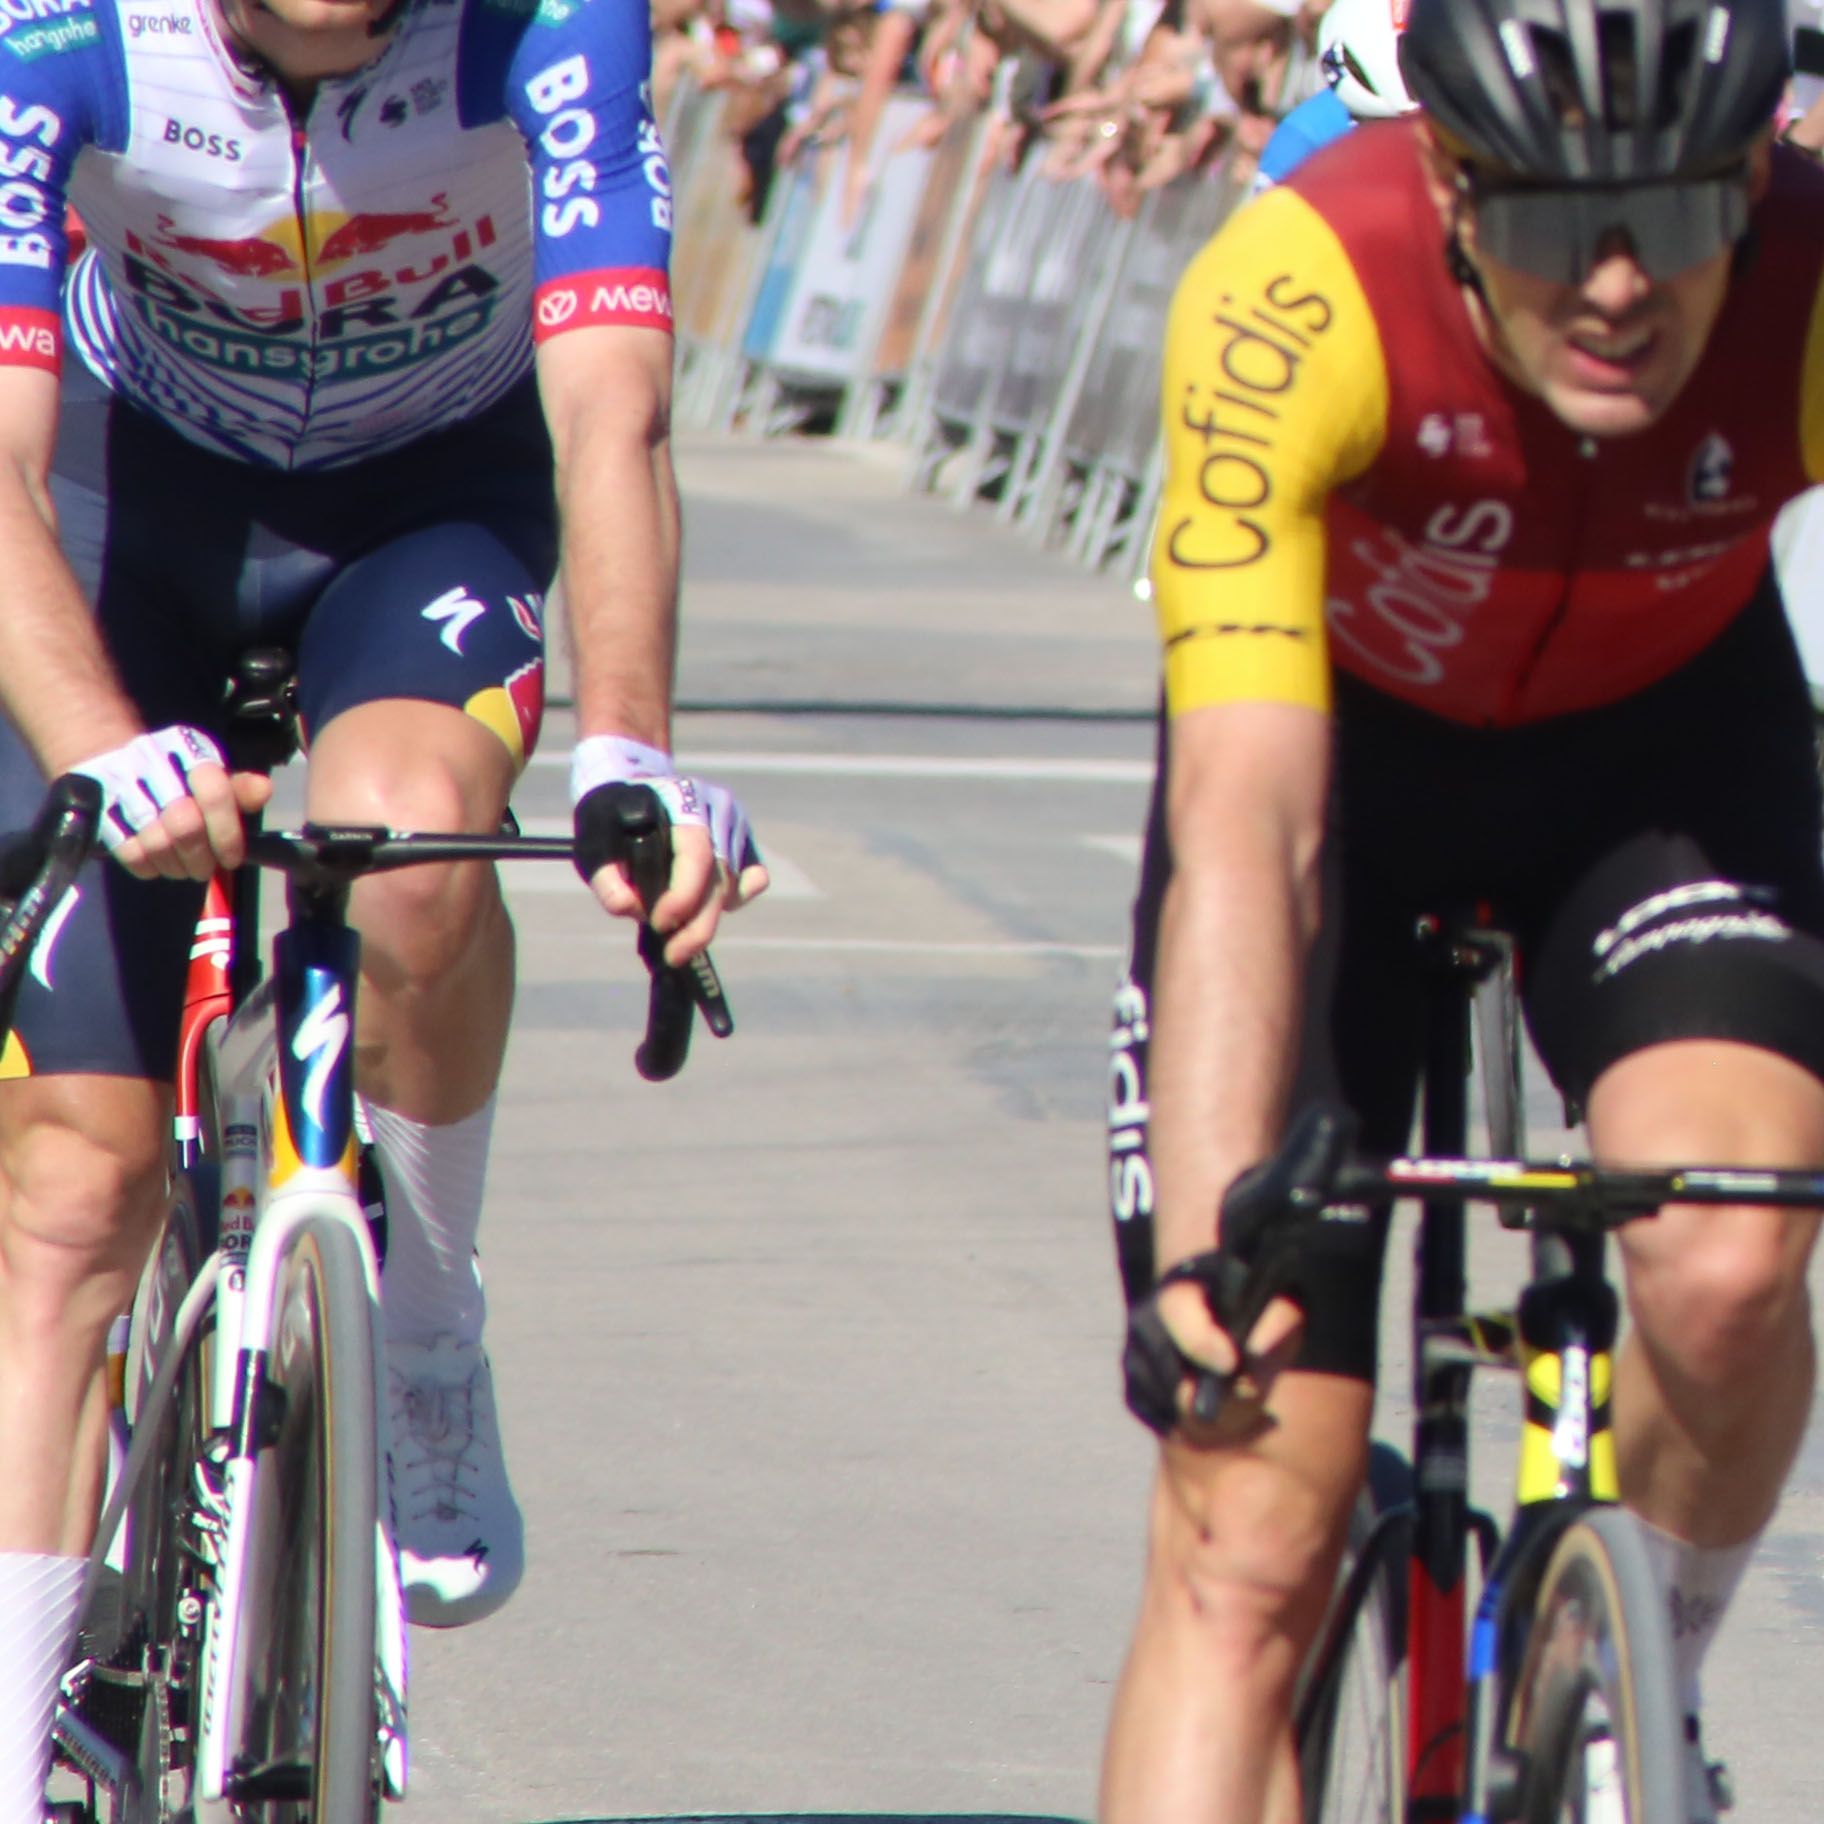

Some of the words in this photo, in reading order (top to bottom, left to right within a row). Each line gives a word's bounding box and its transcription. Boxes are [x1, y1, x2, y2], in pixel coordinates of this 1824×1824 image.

[128, 12, 193, 39] grenke
[0, 94, 63, 272] BOSS
[163, 118, 243, 163] BOSS
[525, 54, 601, 238] BOSS
[324, 214, 497, 307] Bull
[144, 294, 478, 374] hansgrohe
[1167, 274, 1333, 570] Cofidis
